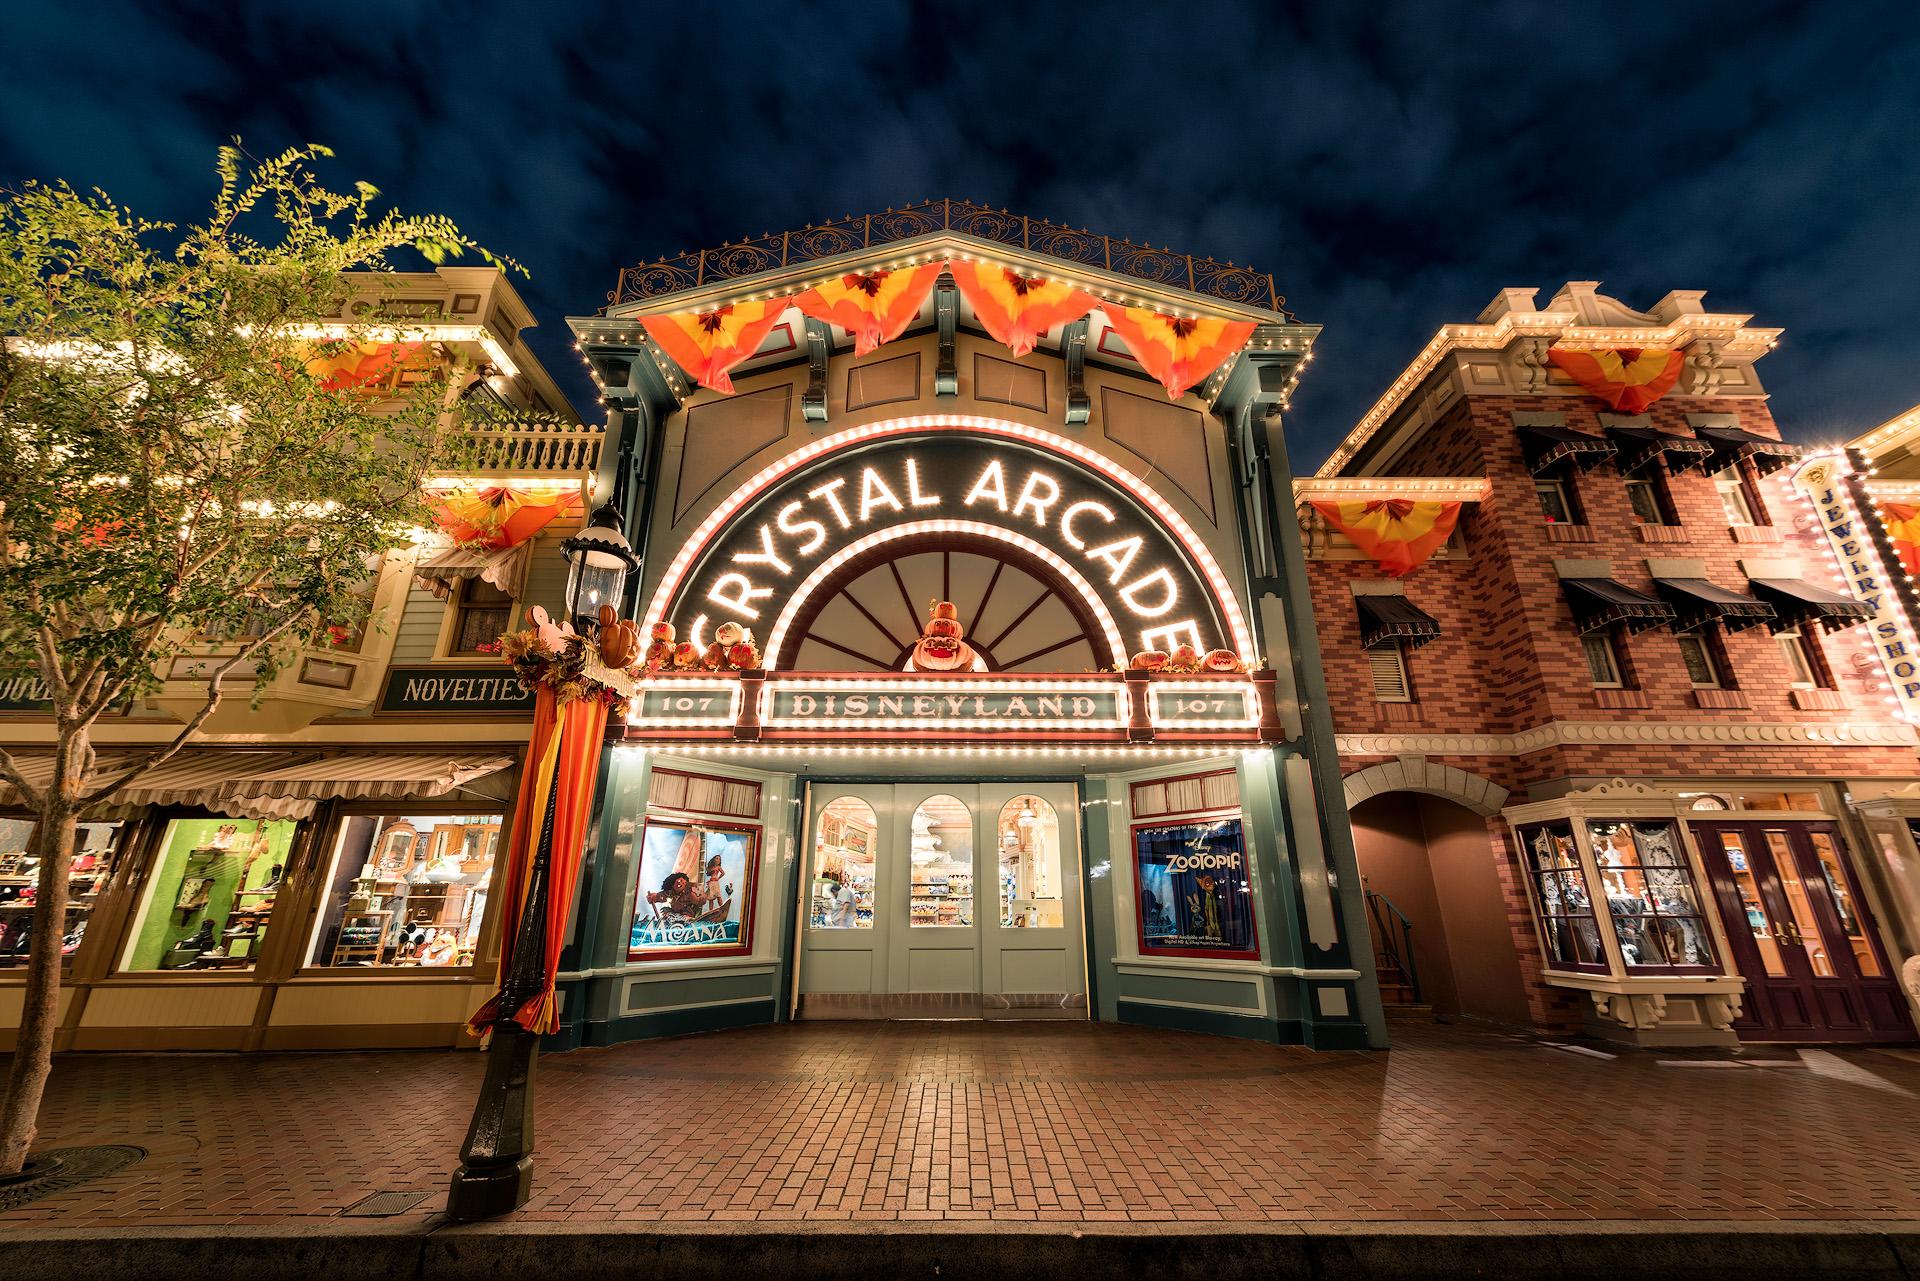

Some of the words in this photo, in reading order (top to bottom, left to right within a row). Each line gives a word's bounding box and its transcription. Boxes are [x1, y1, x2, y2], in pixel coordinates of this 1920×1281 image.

[964, 460, 1204, 657] ARCADE
[1820, 489, 1884, 611] JEWELRY
[1876, 622, 1920, 699] SHOP
[403, 678, 529, 701] NOVELTIES
[662, 697, 715, 711] 107
[792, 695, 1097, 716] DISNEYLAND
[1177, 699, 1225, 713] 107
[1164, 852, 1241, 873] ZOOTOPIA
[640, 920, 727, 943] MOANA
